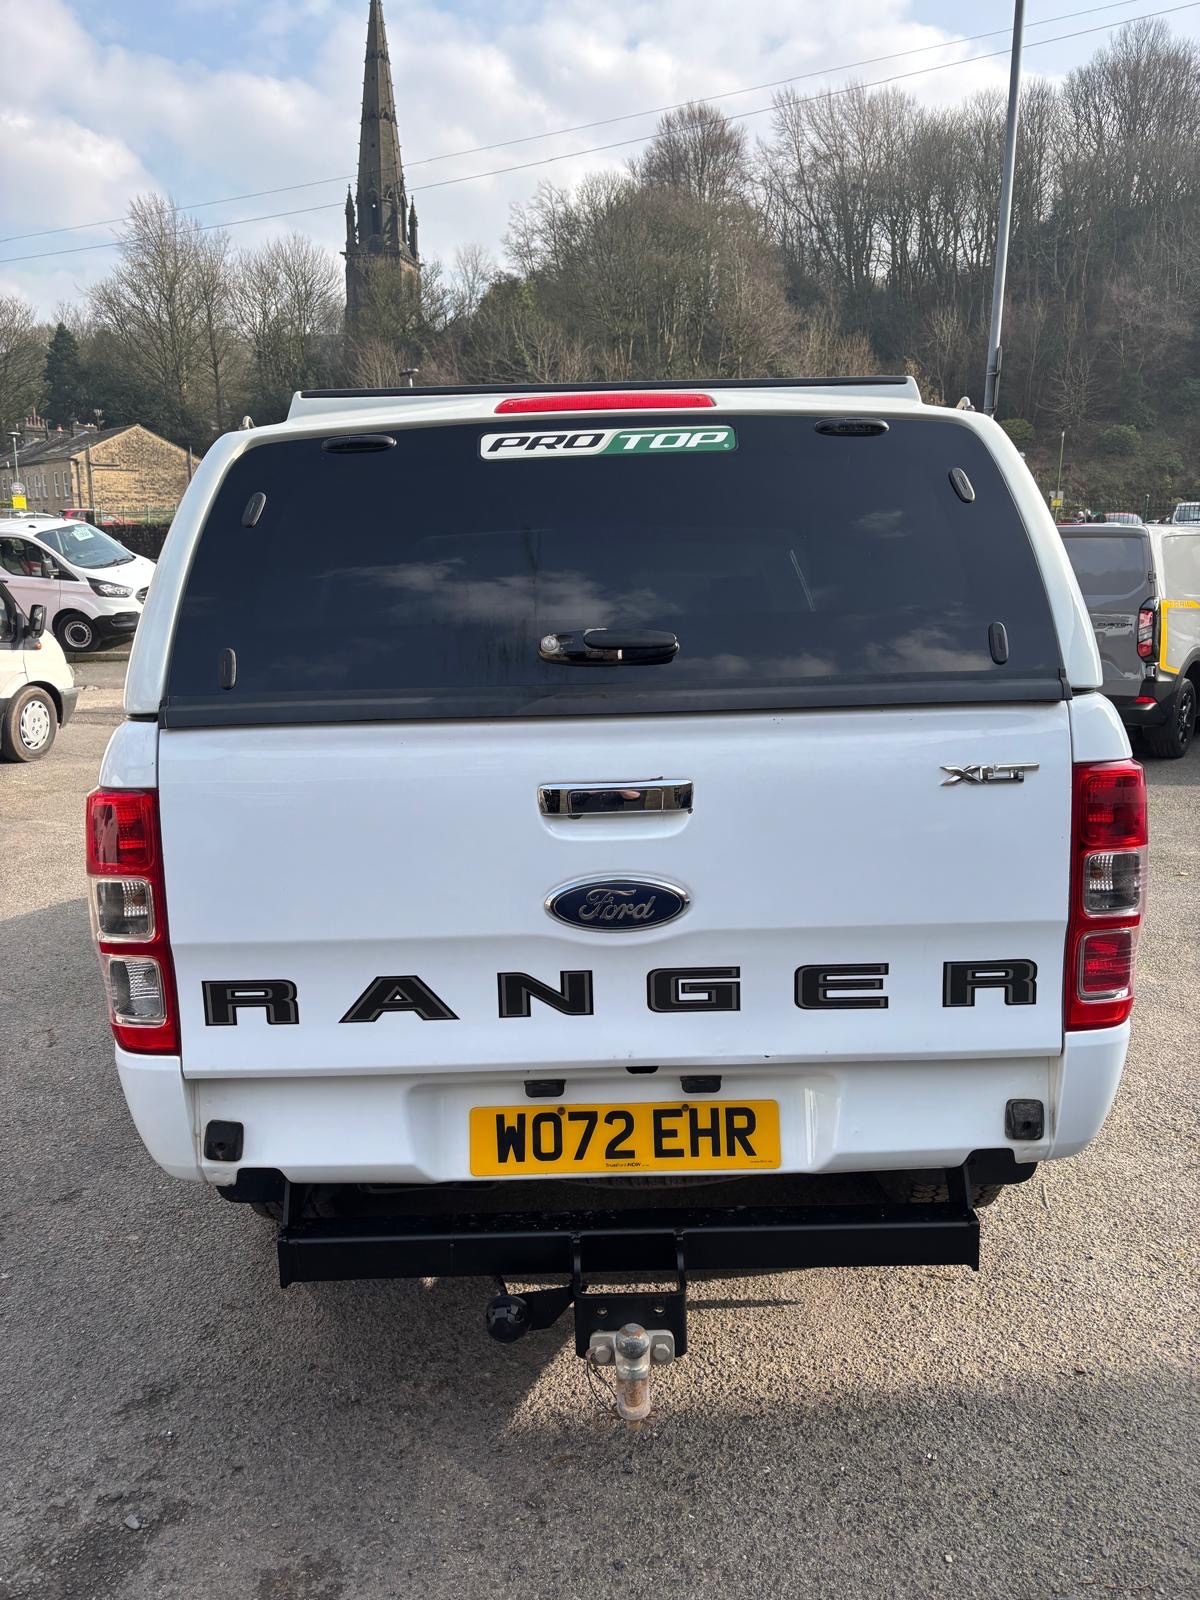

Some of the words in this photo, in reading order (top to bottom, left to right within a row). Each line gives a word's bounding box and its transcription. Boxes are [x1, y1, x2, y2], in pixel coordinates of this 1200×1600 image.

[940, 763, 1039, 786] XLT
[578, 888, 656, 920] Ford
[201, 958, 1038, 1026] RANGER
[496, 1110, 636, 1163] WO72
[652, 1107, 757, 1158] EHR
